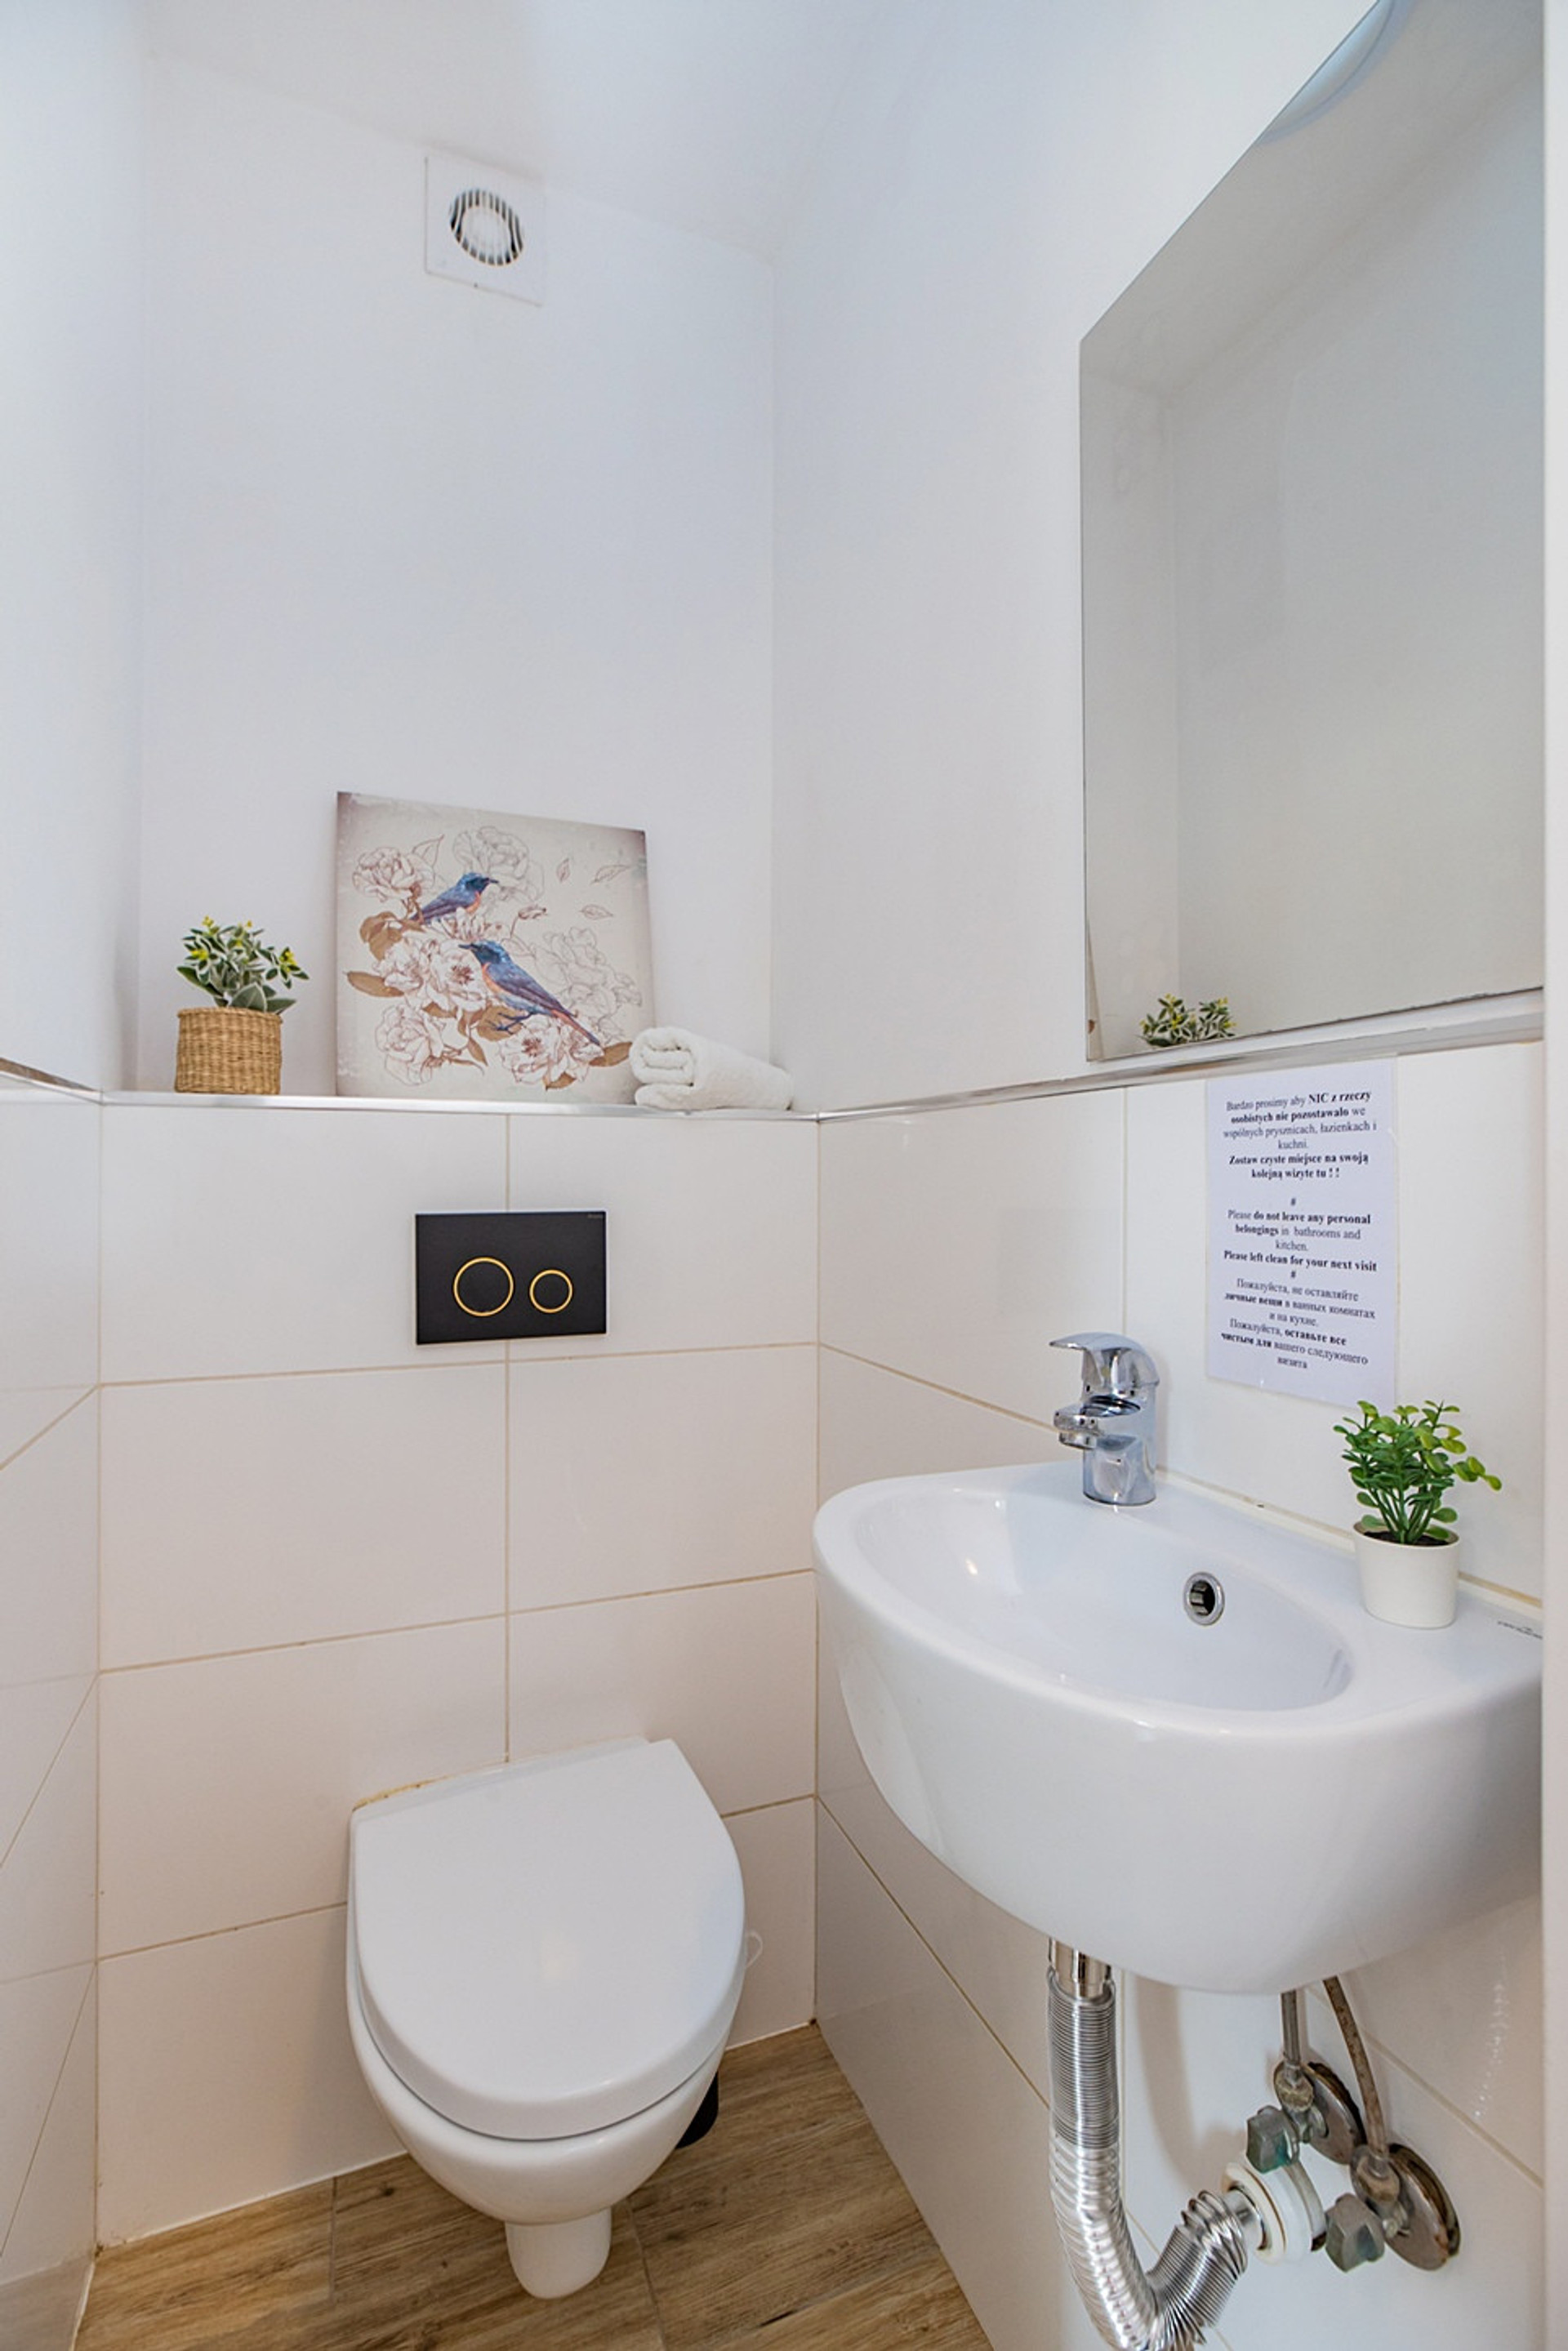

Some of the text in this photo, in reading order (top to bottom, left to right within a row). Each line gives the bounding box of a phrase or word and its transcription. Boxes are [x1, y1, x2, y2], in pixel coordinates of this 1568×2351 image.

[1227, 1091, 1371, 1111] Bardzo prosimy aby NIC z rzeczy
[1231, 1112, 1273, 1124] osobistych
[1276, 1111, 1288, 1121] nie
[1352, 1107, 1365, 1116] we
[1265, 1123, 1318, 1139] prysznicach,
[1373, 1121, 1377, 1131] i
[1229, 1151, 1369, 1167] Zostaw czyste miejsce na swoją
[1251, 1169, 1283, 1181] kolejną
[1316, 1169, 1326, 1178] tu
[1227, 1209, 1370, 1226] Please do not leave any personal
[1235, 1223, 1361, 1240] belongings in bathrooms and
[1275, 1240, 1308, 1252] kitchen.
[1224, 1250, 1377, 1272] Please left clean for your next visit
[1236, 1277, 1359, 1302] Пожалуйста, не оставляйте
[1224, 1293, 1258, 1304] личные
[1293, 1301, 1326, 1313] ванных
[1329, 1306, 1375, 1320] комнатах
[1269, 1312, 1275, 1320] и
[1277, 1313, 1288, 1322] на
[1230, 1317, 1347, 1346] Пожалуйста, оставьте все
[1255, 1338, 1272, 1347] для
[1274, 1342, 1306, 1354] вашего
